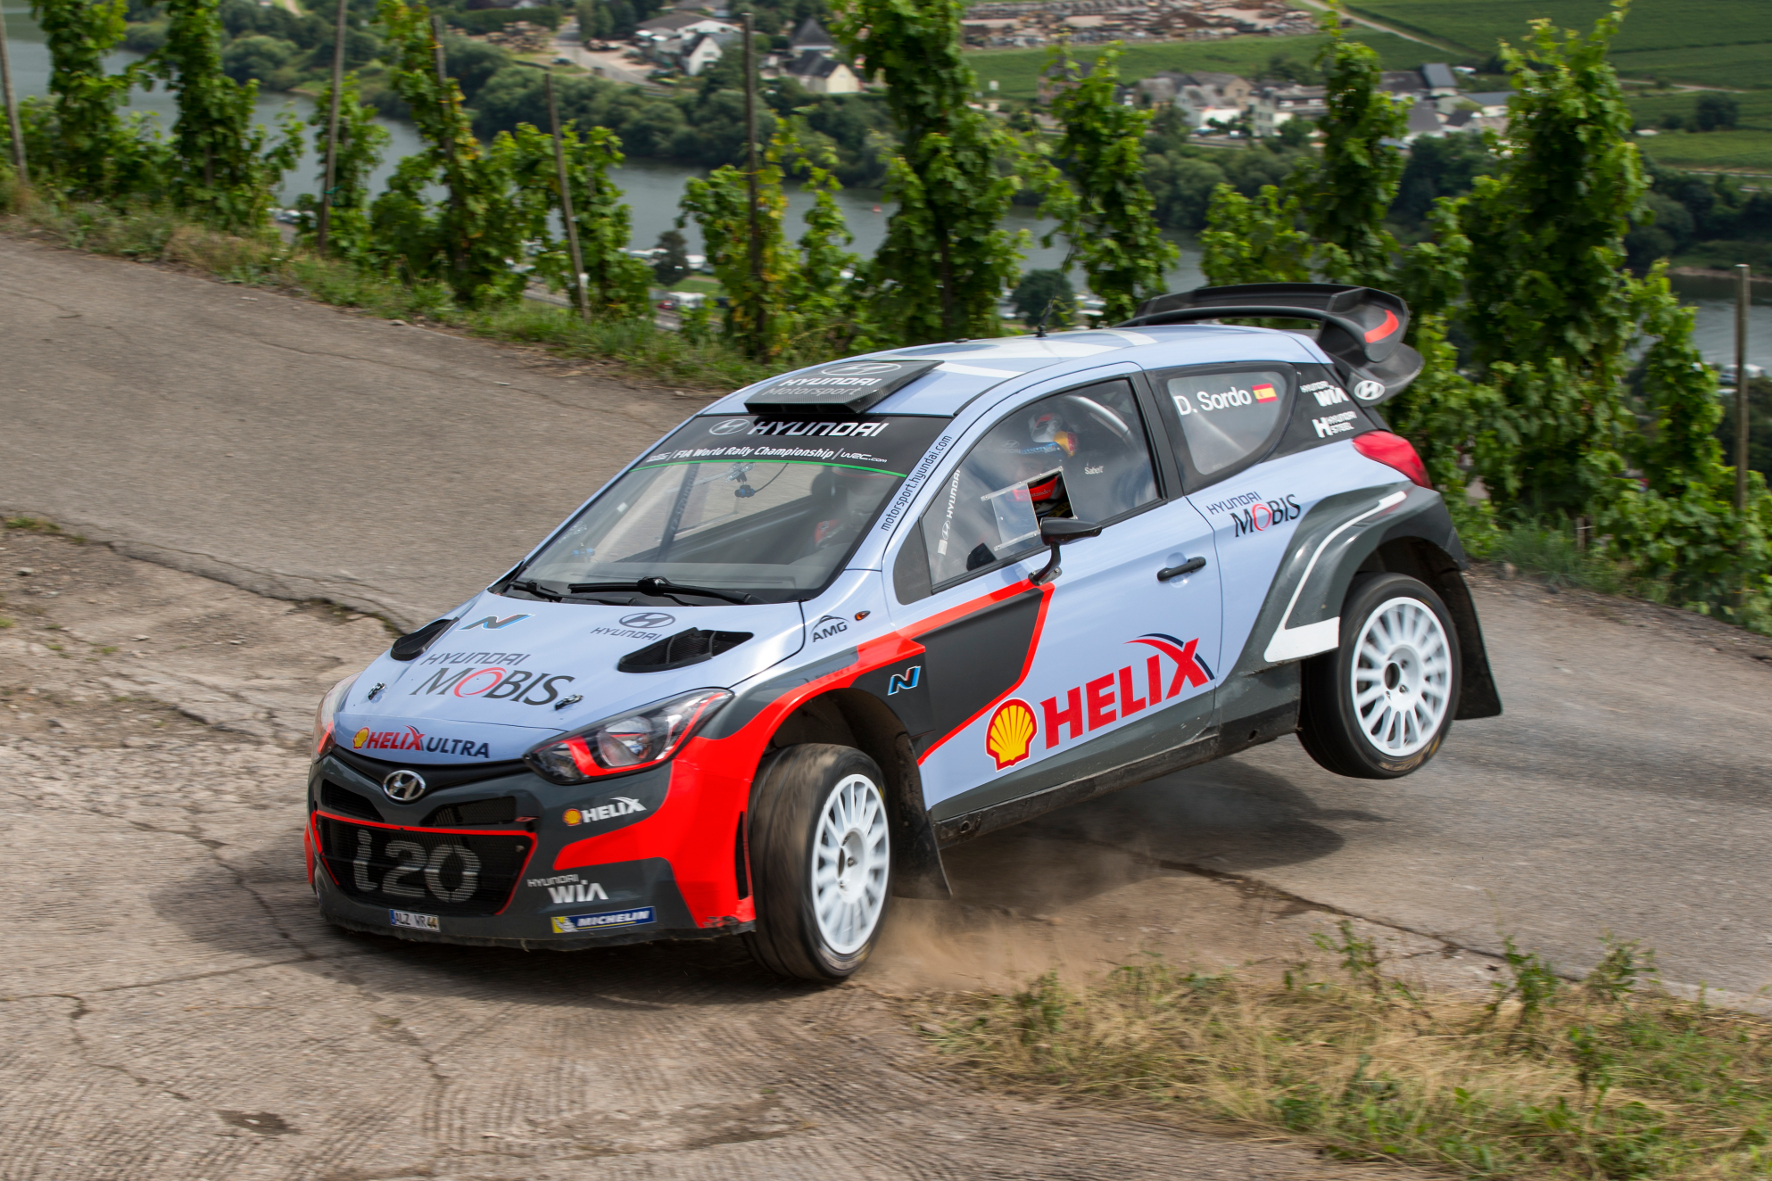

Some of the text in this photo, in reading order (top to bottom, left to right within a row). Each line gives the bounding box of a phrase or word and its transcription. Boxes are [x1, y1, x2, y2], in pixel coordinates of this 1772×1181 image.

[762, 386, 862, 397] Motorsport
[779, 377, 882, 387] HYUNDAI
[1172, 386, 1252, 416] D. Sordo
[1313, 385, 1349, 407] WIA
[747, 421, 890, 437] HYUNDAI
[673, 449, 694, 459] FIA
[693, 447, 727, 457] World
[724, 446, 755, 457] Rally
[754, 446, 834, 460] Championship
[880, 435, 952, 532] motorsport.hyundai.com
[946, 469, 961, 519] HYUNDAI
[1205, 491, 1263, 515] HYUNDAI
[1229, 494, 1301, 538] MOBIS
[590, 627, 663, 641] HYUNDAI
[812, 621, 848, 643] AMG
[420, 651, 531, 667] HYUNDAI
[408, 667, 576, 706] MOBIS
[1039, 633, 1215, 750] HELIX
[366, 725, 490, 759] HELIX ULTRA
[581, 796, 648, 823] HELIX
[353, 829, 482, 903] i20
[527, 873, 579, 888] HYUNDAI
[547, 879, 609, 904] WIA
[576, 910, 651, 927] MICHELIN
